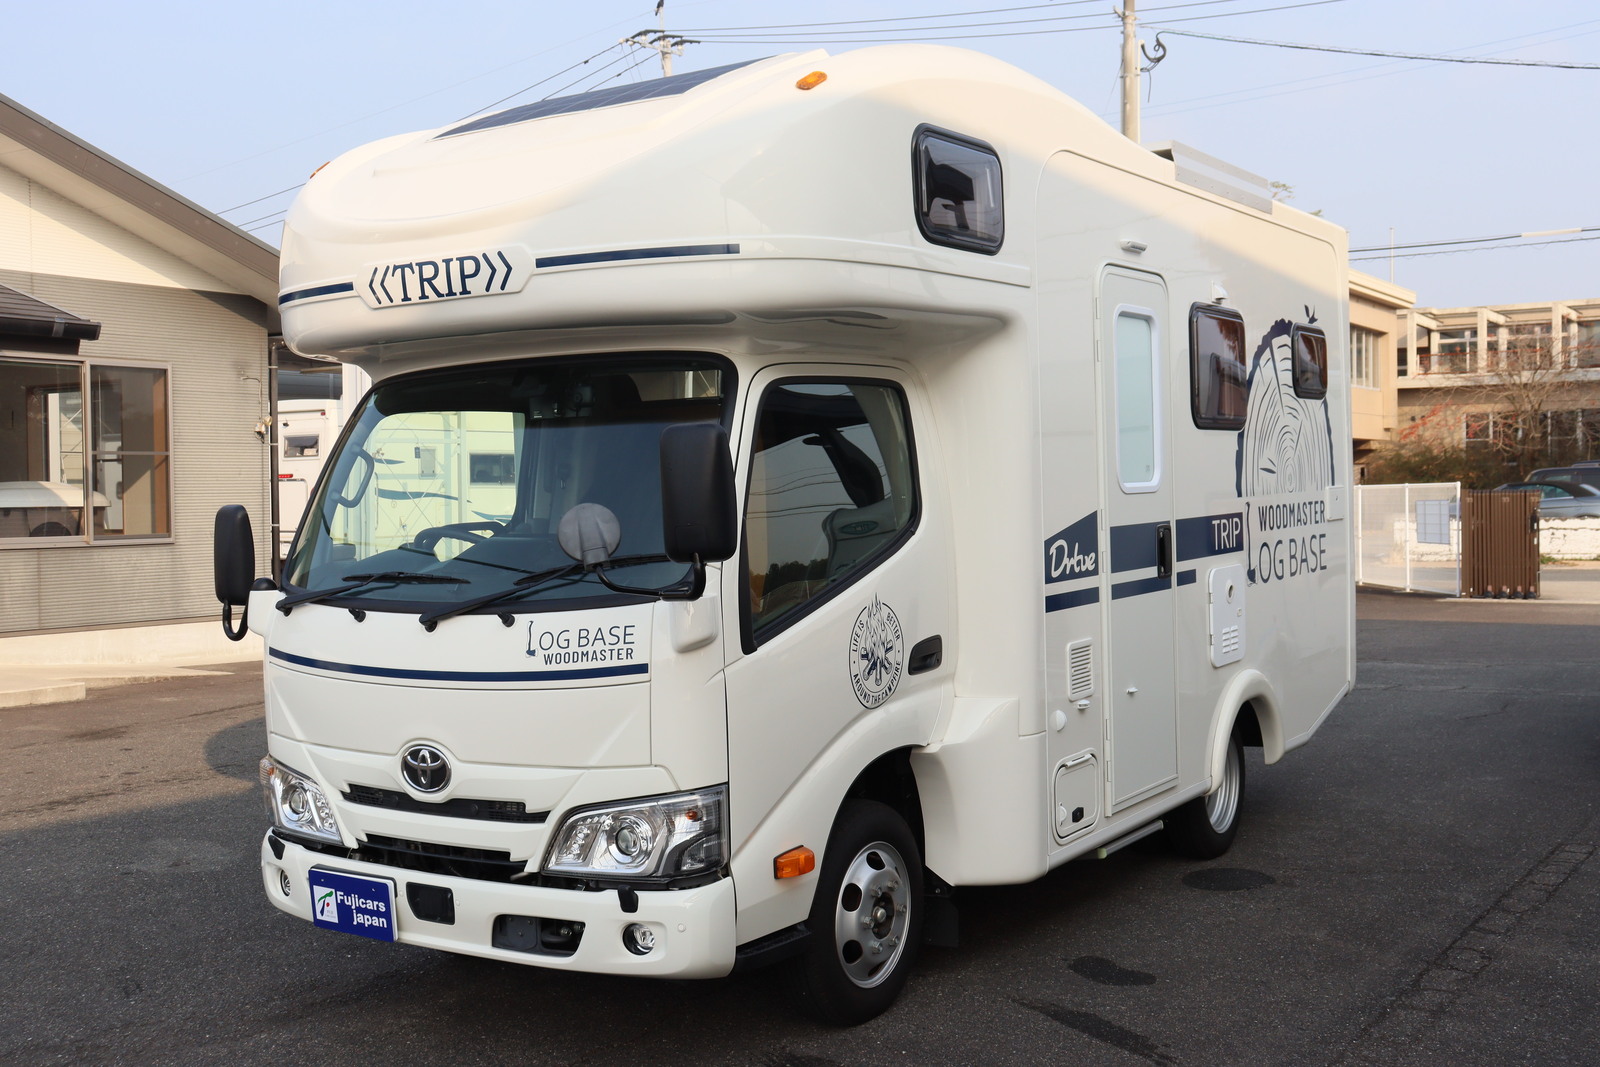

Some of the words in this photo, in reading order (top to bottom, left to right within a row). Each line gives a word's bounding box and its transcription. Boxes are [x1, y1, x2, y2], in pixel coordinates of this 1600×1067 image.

[391, 255, 482, 303] TRIP
[1258, 500, 1326, 532] WOODMASTER
[1211, 517, 1241, 551] TRIP
[1289, 533, 1328, 578] BASE
[578, 625, 635, 647] BASE
[852, 631, 861, 652] LIFE
[858, 619, 865, 632] IS
[887, 612, 900, 641] BETTER
[544, 648, 633, 665] WOODMASTER
[853, 674, 870, 703] AROUND
[871, 693, 880, 705] THE
[881, 661, 901, 701] CAMPFIRE
[337, 891, 386, 911] Fujicars
[353, 911, 387, 928] japan
